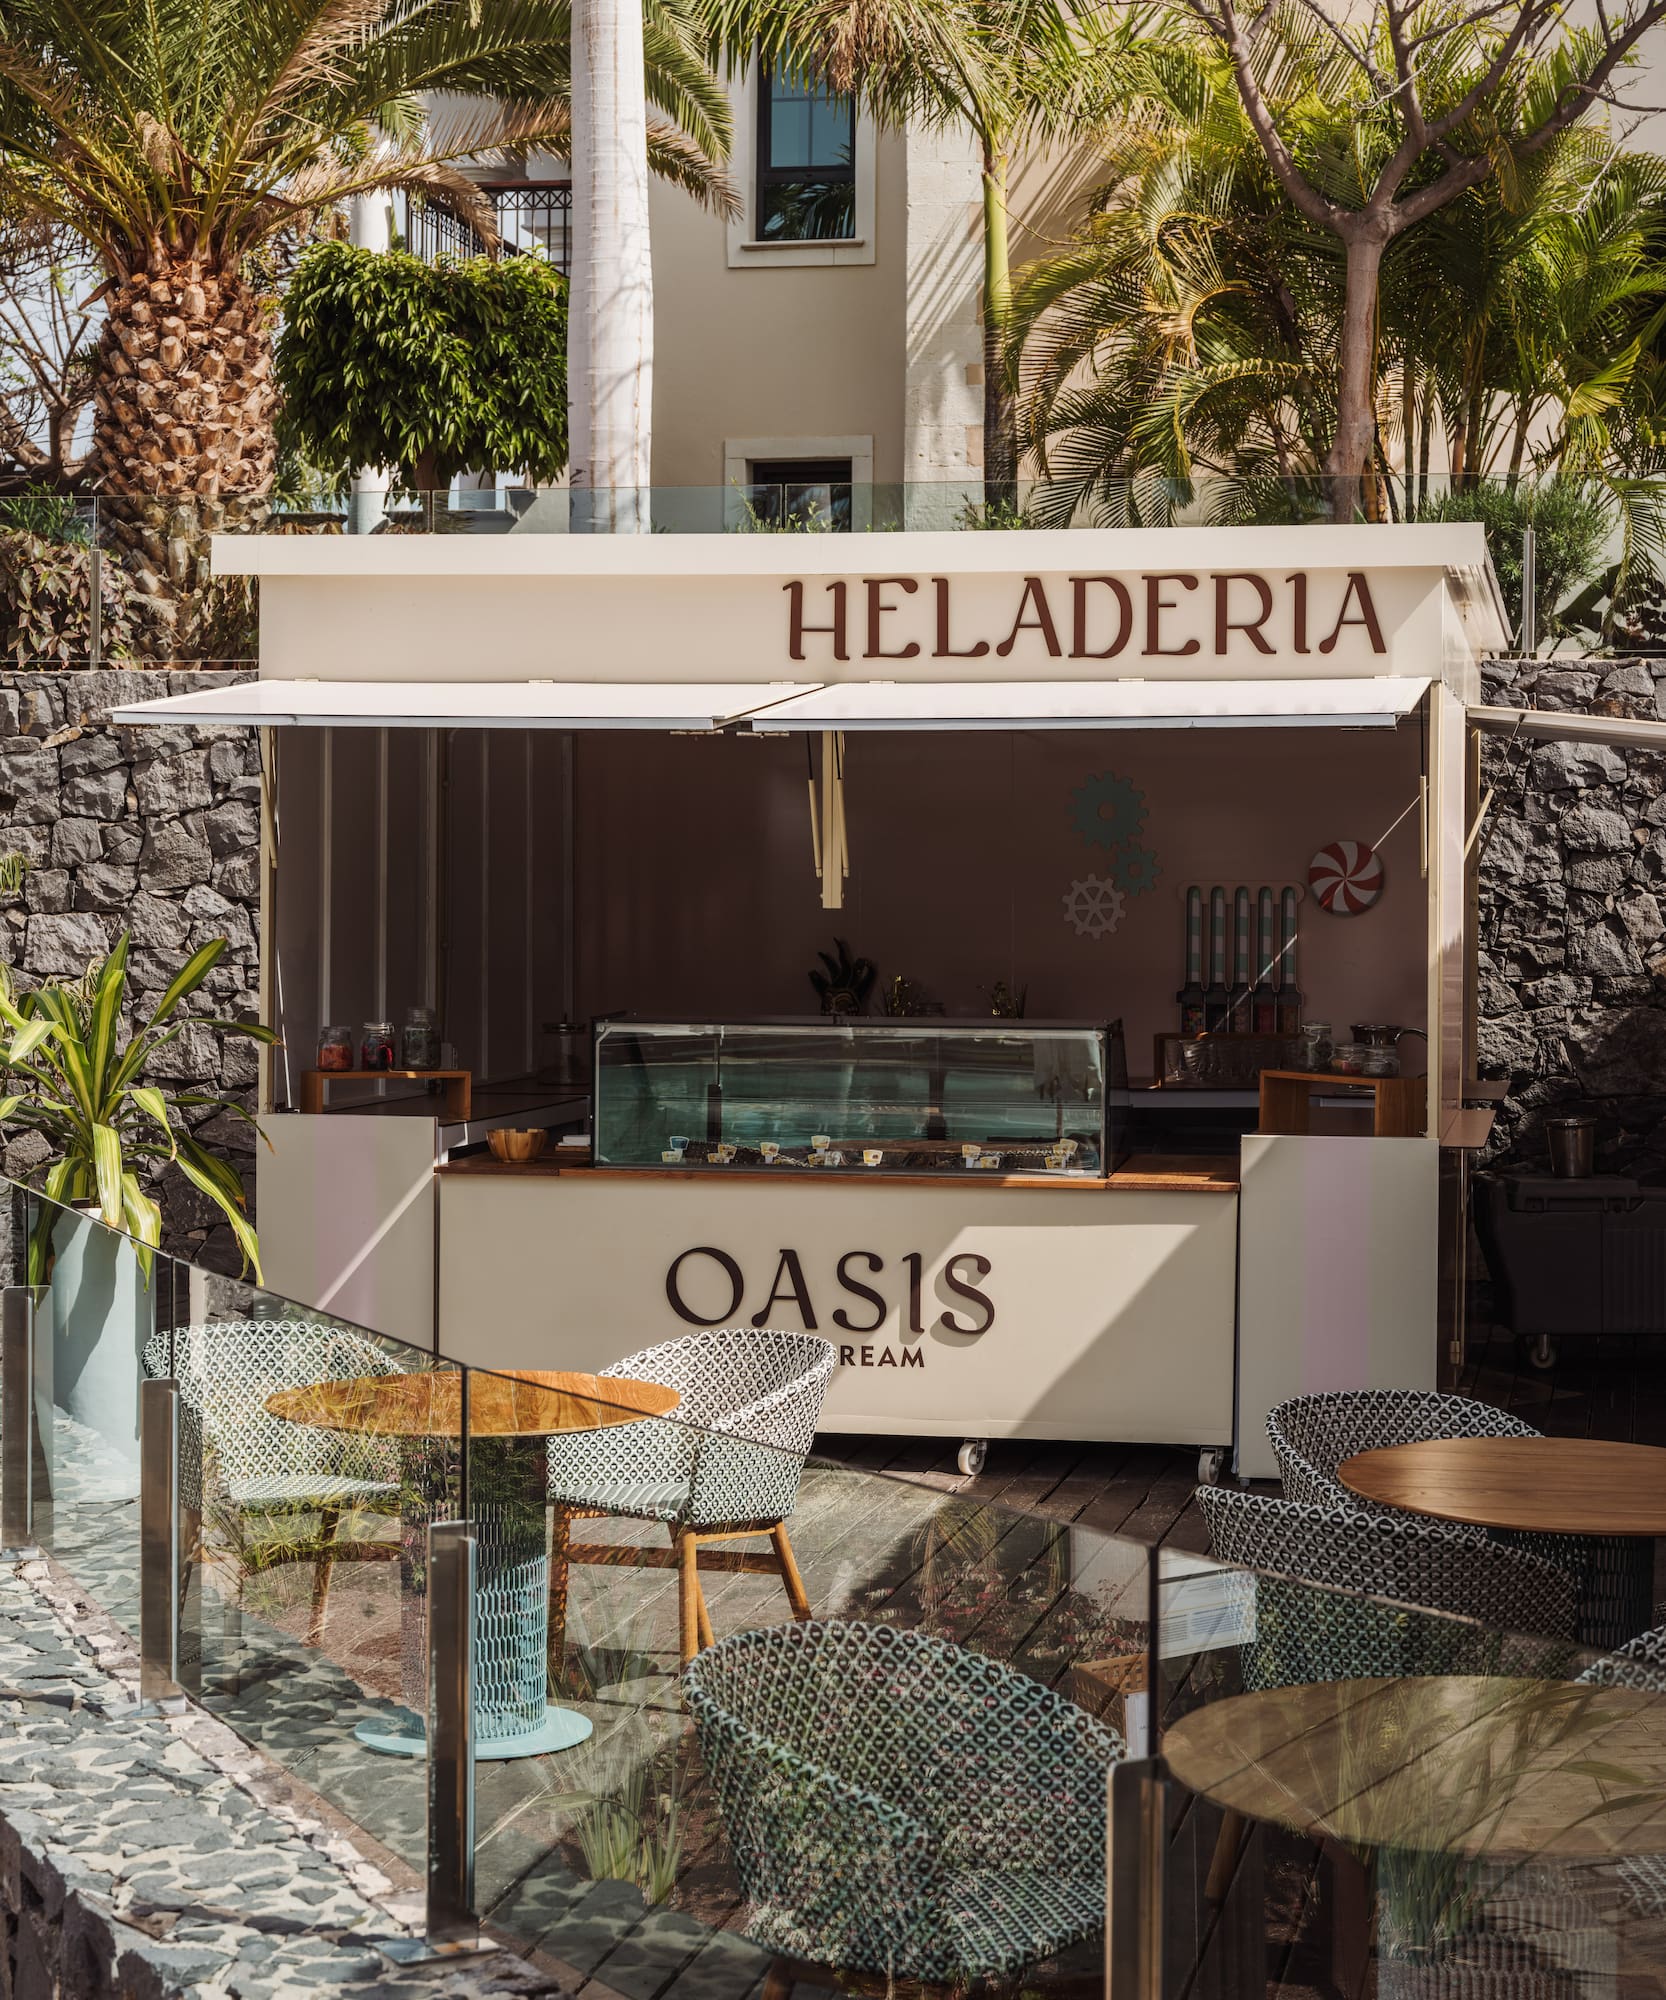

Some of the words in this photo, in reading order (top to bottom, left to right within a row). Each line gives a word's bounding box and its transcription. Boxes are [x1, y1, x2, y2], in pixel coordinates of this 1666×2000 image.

[782, 572, 1387, 661] HELADERIA
[666, 1246, 995, 1335] OASIS
[839, 1345, 925, 1368] REAM
